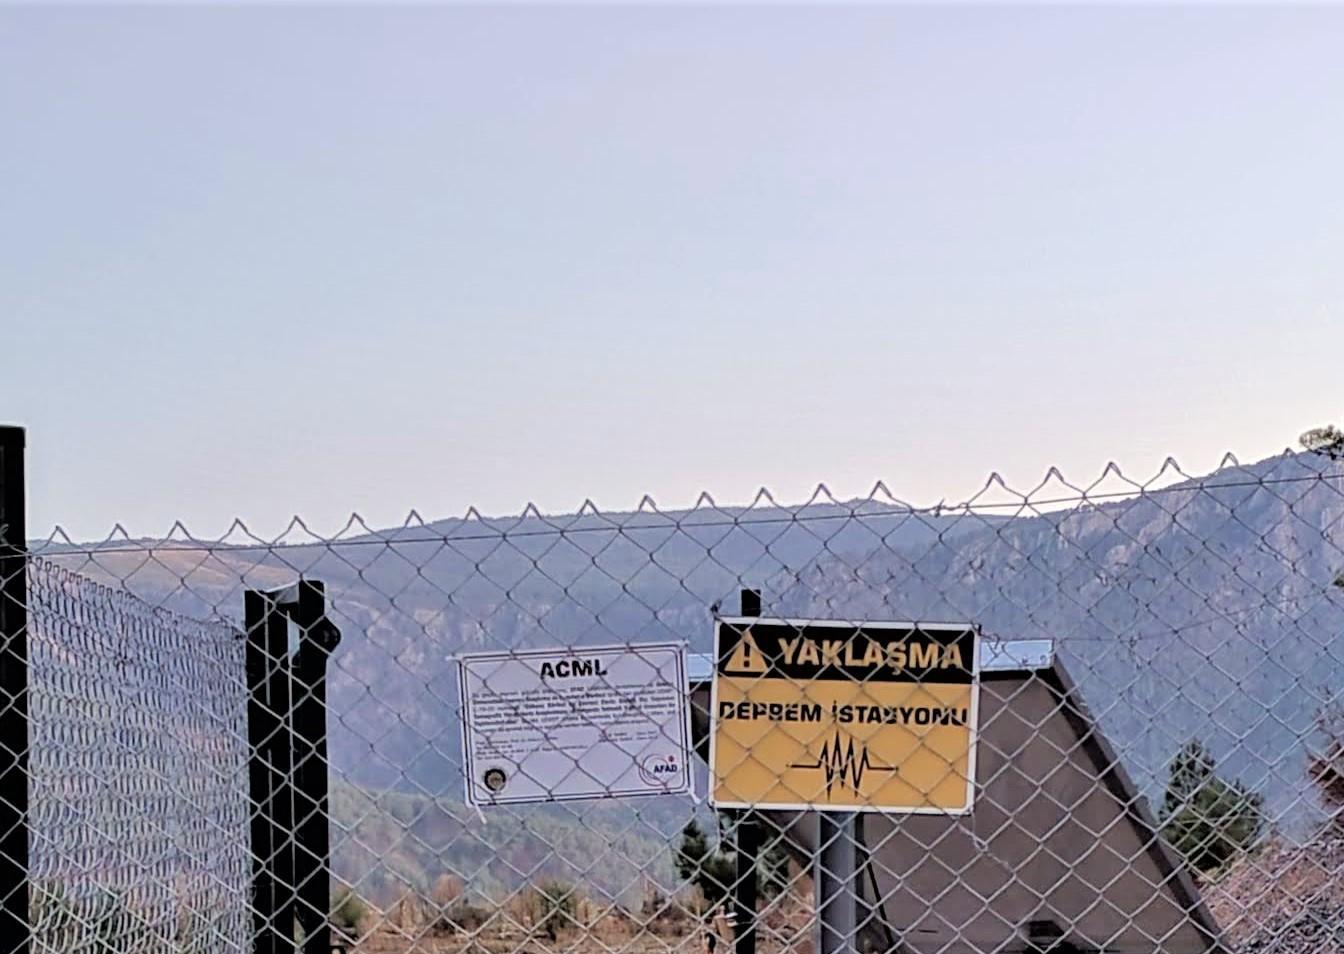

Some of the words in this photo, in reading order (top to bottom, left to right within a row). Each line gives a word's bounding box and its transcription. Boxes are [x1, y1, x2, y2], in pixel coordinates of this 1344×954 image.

[778, 638, 963, 675] YAKLAŞMA
[541, 659, 607, 678] ACML
[720, 701, 821, 722] DEPREM
[832, 701, 967, 725] İSTASYONU
[653, 764, 677, 773] AFAD
